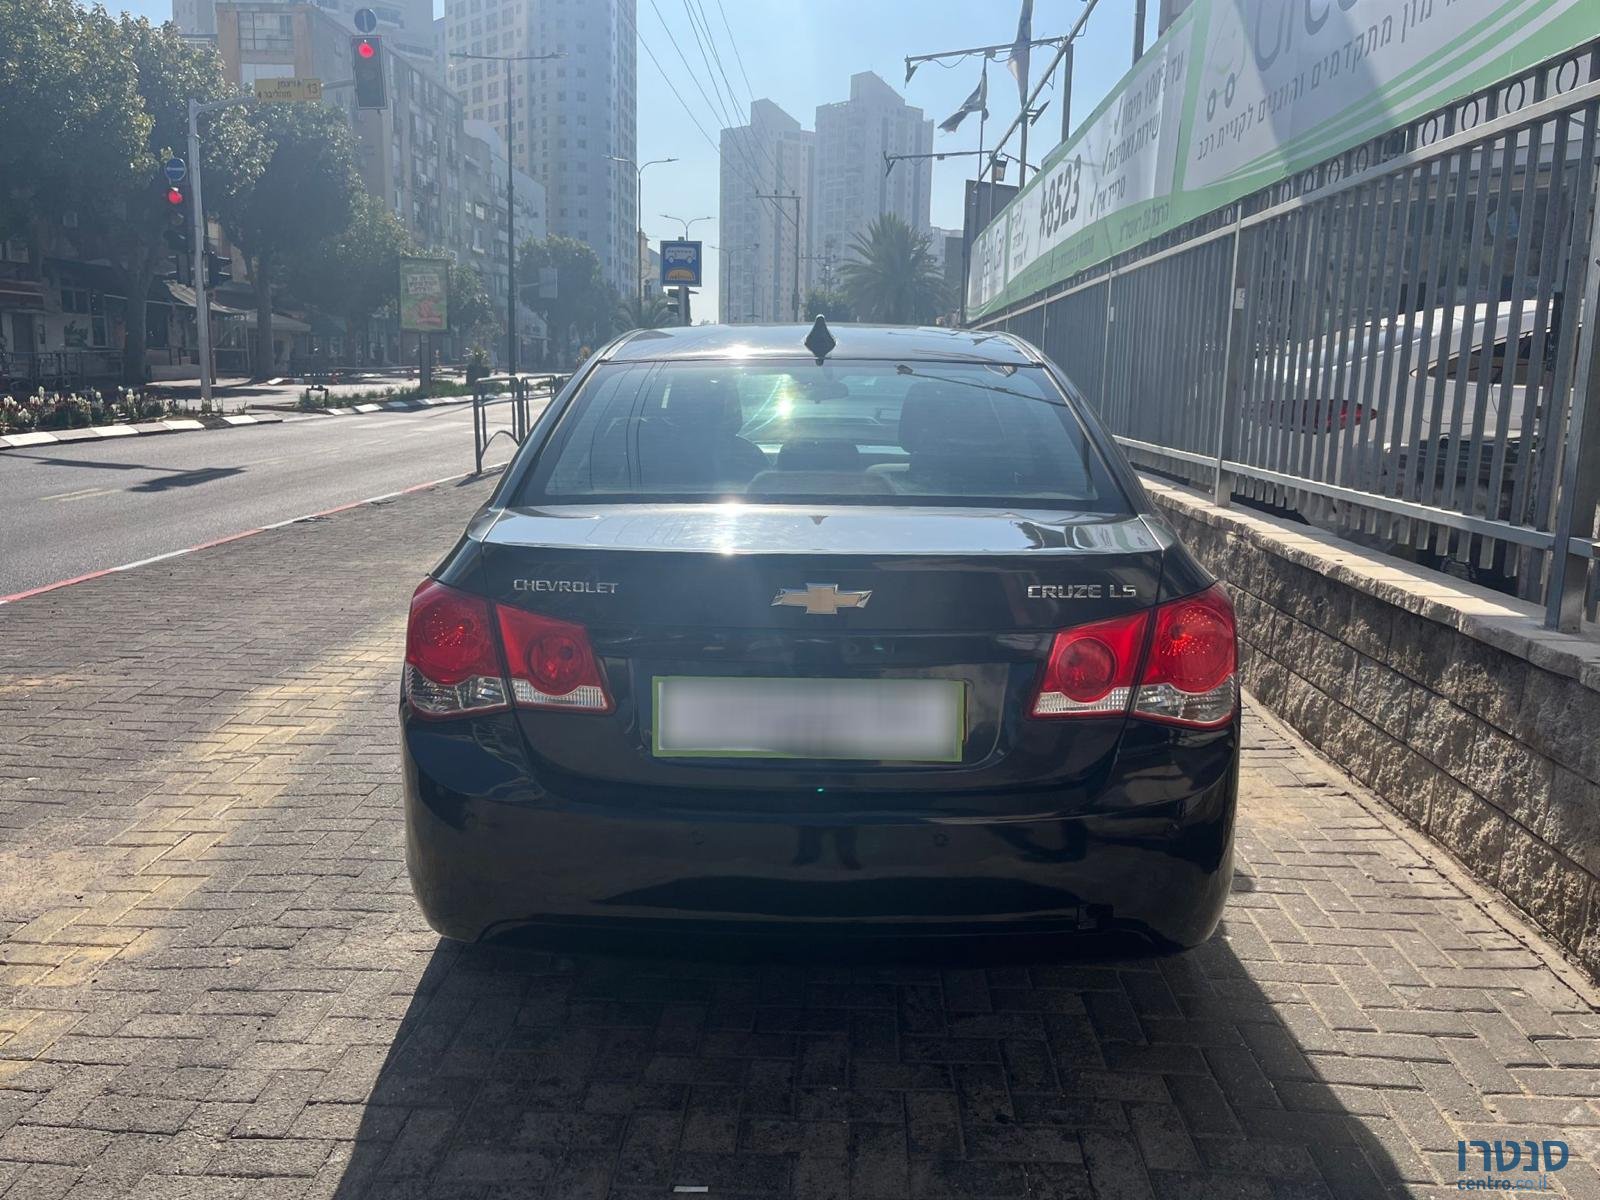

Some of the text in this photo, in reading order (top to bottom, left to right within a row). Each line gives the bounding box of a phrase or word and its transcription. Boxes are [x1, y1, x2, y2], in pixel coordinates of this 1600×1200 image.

[1311, 14, 1393, 90] מתקדמים
[307, 82, 318, 95] 13
[1217, 103, 1254, 149] לקניית
[1198, 133, 1214, 160] רכב
[513, 579, 619, 594] CHEVROLET
[1027, 584, 1137, 599] CRUZE LS
